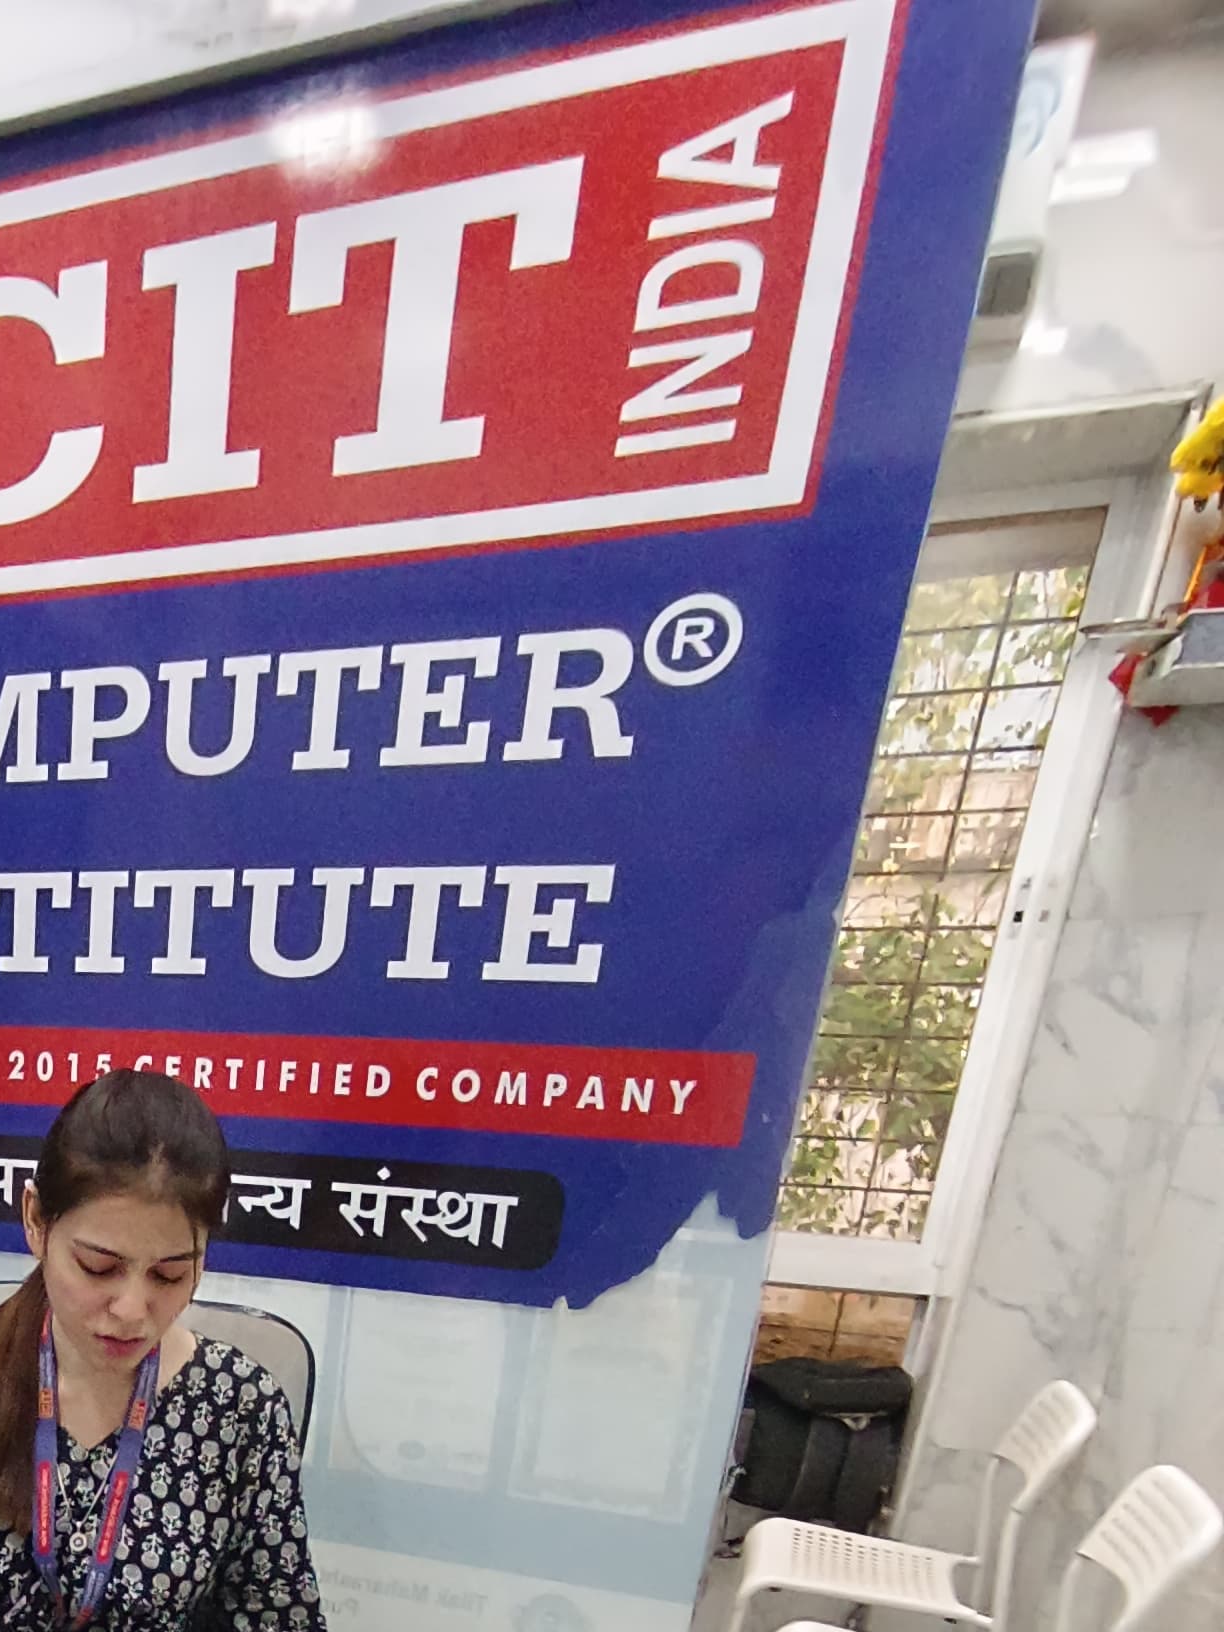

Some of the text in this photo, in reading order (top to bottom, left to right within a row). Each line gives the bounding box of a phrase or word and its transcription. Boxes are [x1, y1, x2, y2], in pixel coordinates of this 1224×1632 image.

[614, 91, 794, 457] INDIA
[8, 1050, 112, 1082] 2015
[416, 1066, 697, 1115] COMPANY
[224, 1173, 313, 1231] न्य
[331, 1166, 519, 1250] संस्था
